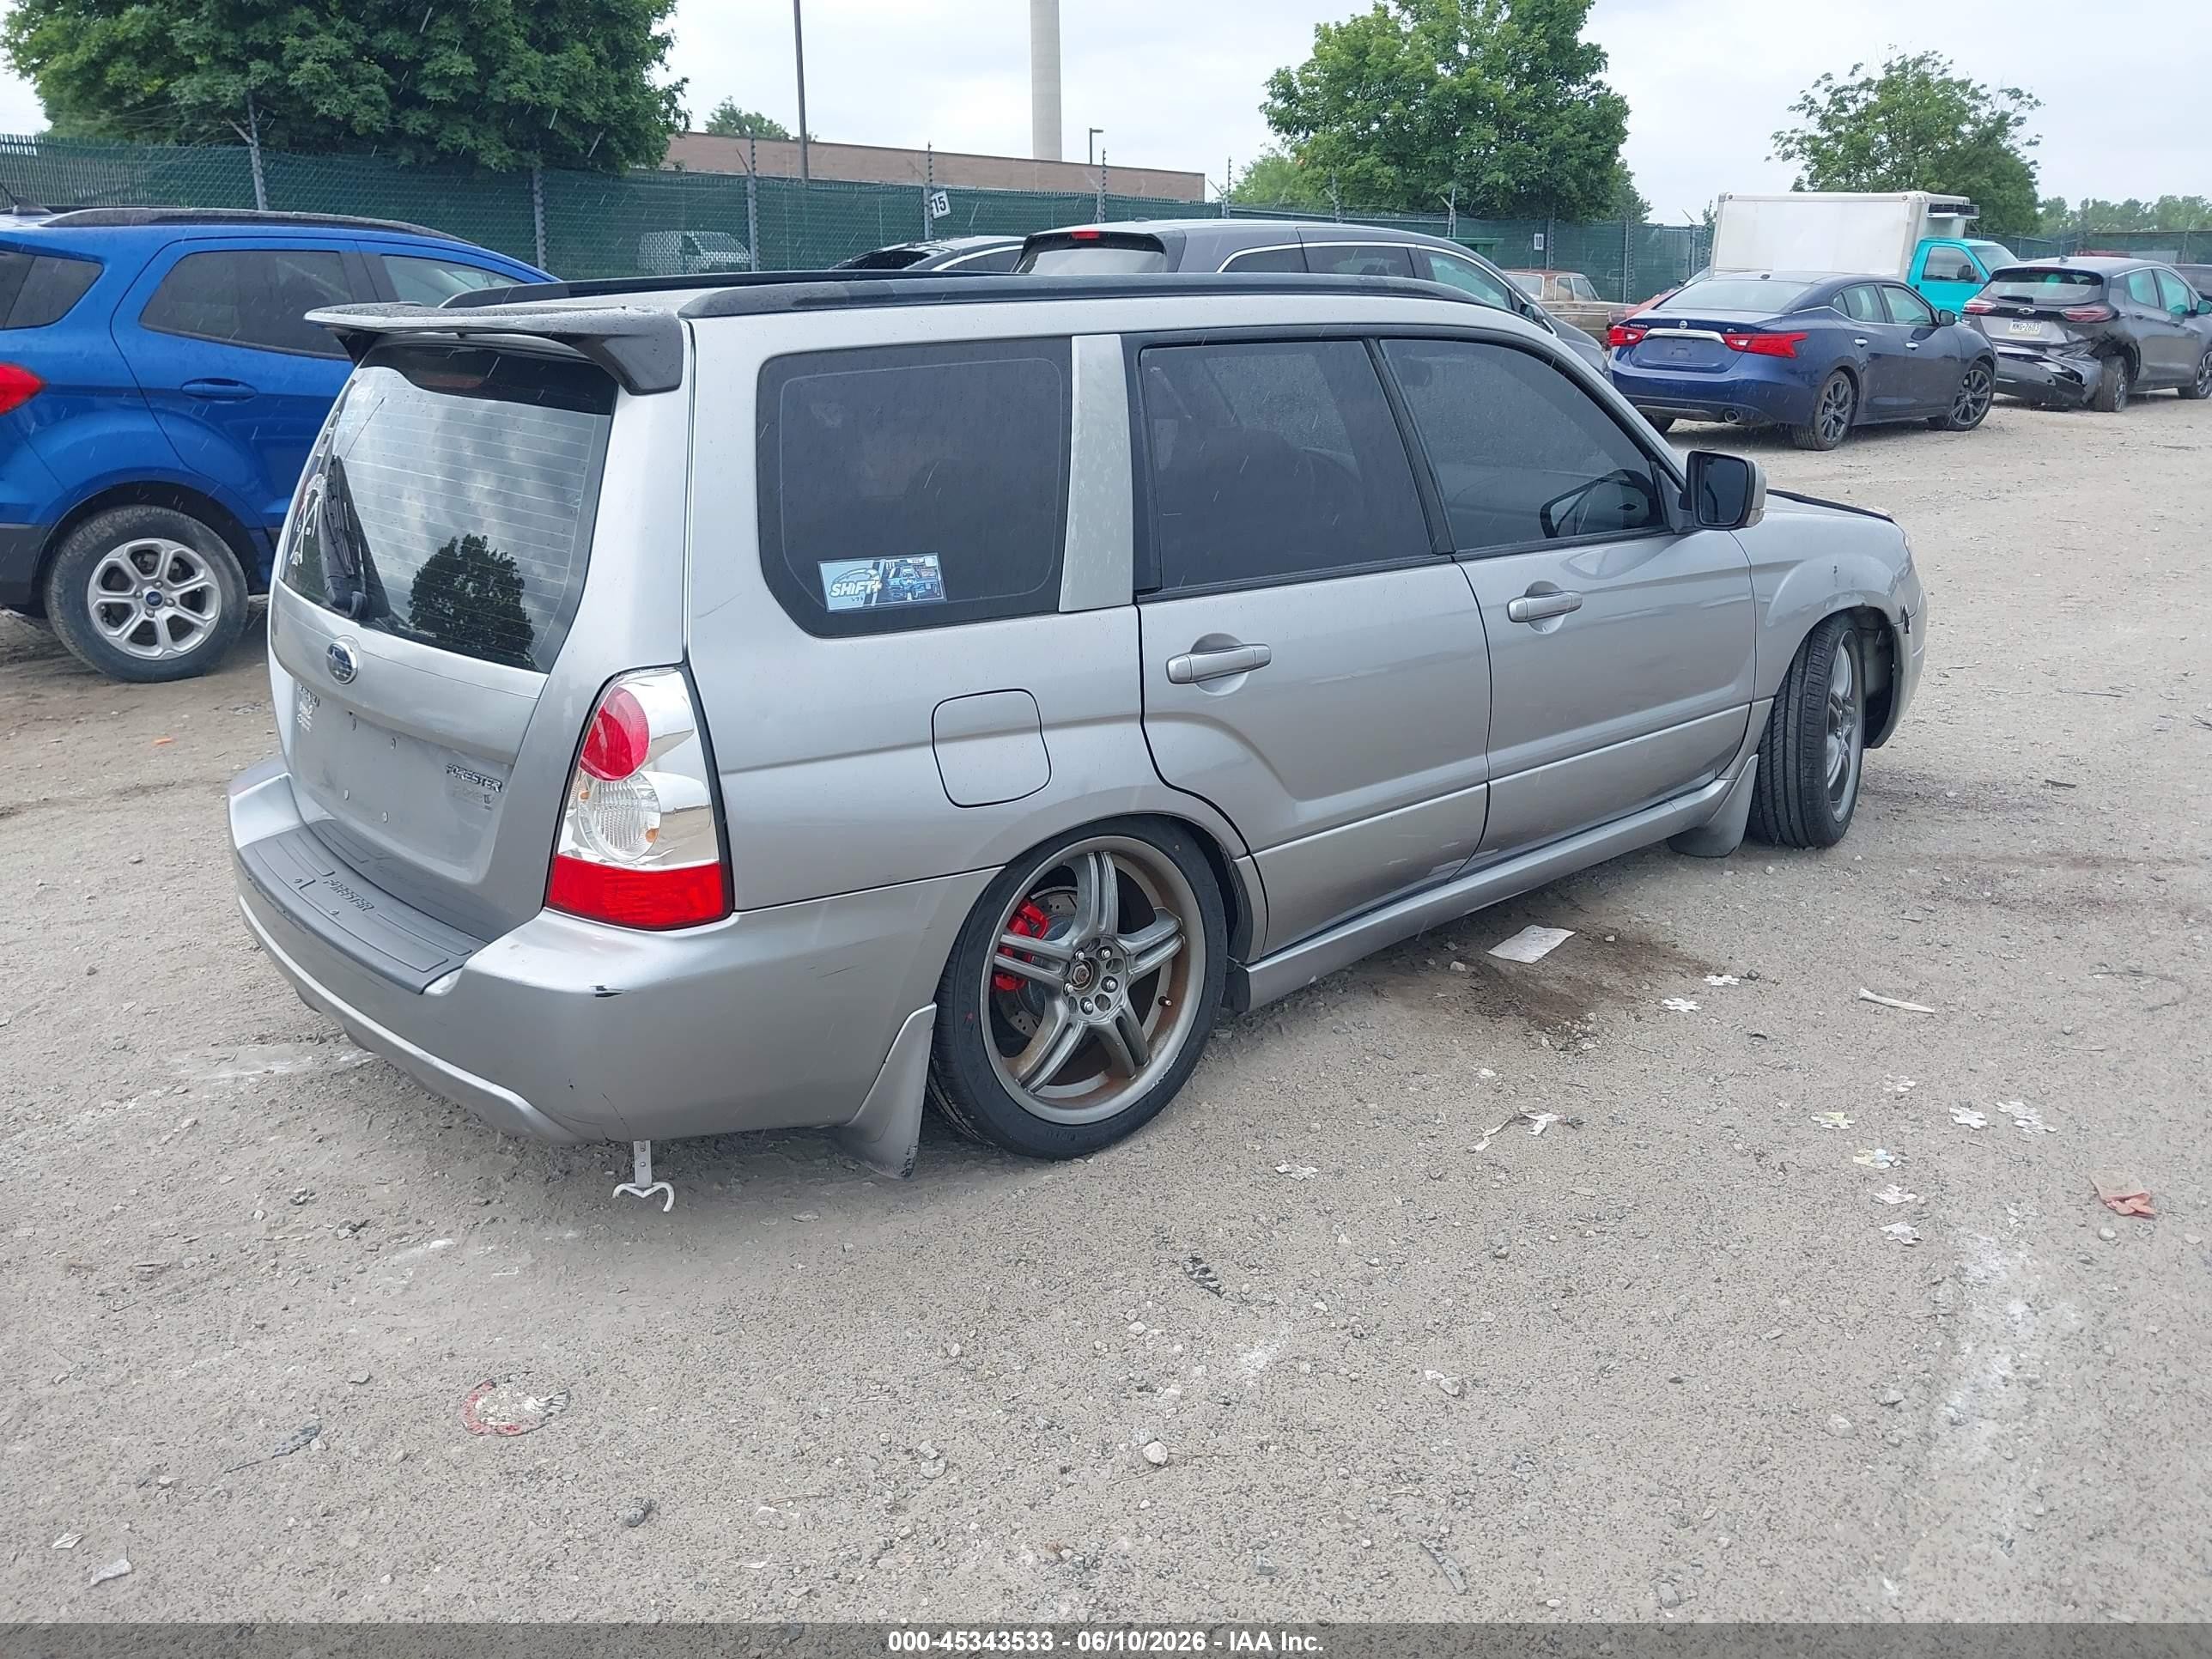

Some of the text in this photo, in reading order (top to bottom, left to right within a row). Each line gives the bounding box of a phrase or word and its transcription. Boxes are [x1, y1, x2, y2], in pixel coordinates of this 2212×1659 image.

[933, 196, 946, 213] 15
[1535, 235, 1543, 248] 10
[445, 763, 503, 793] FORESTER
